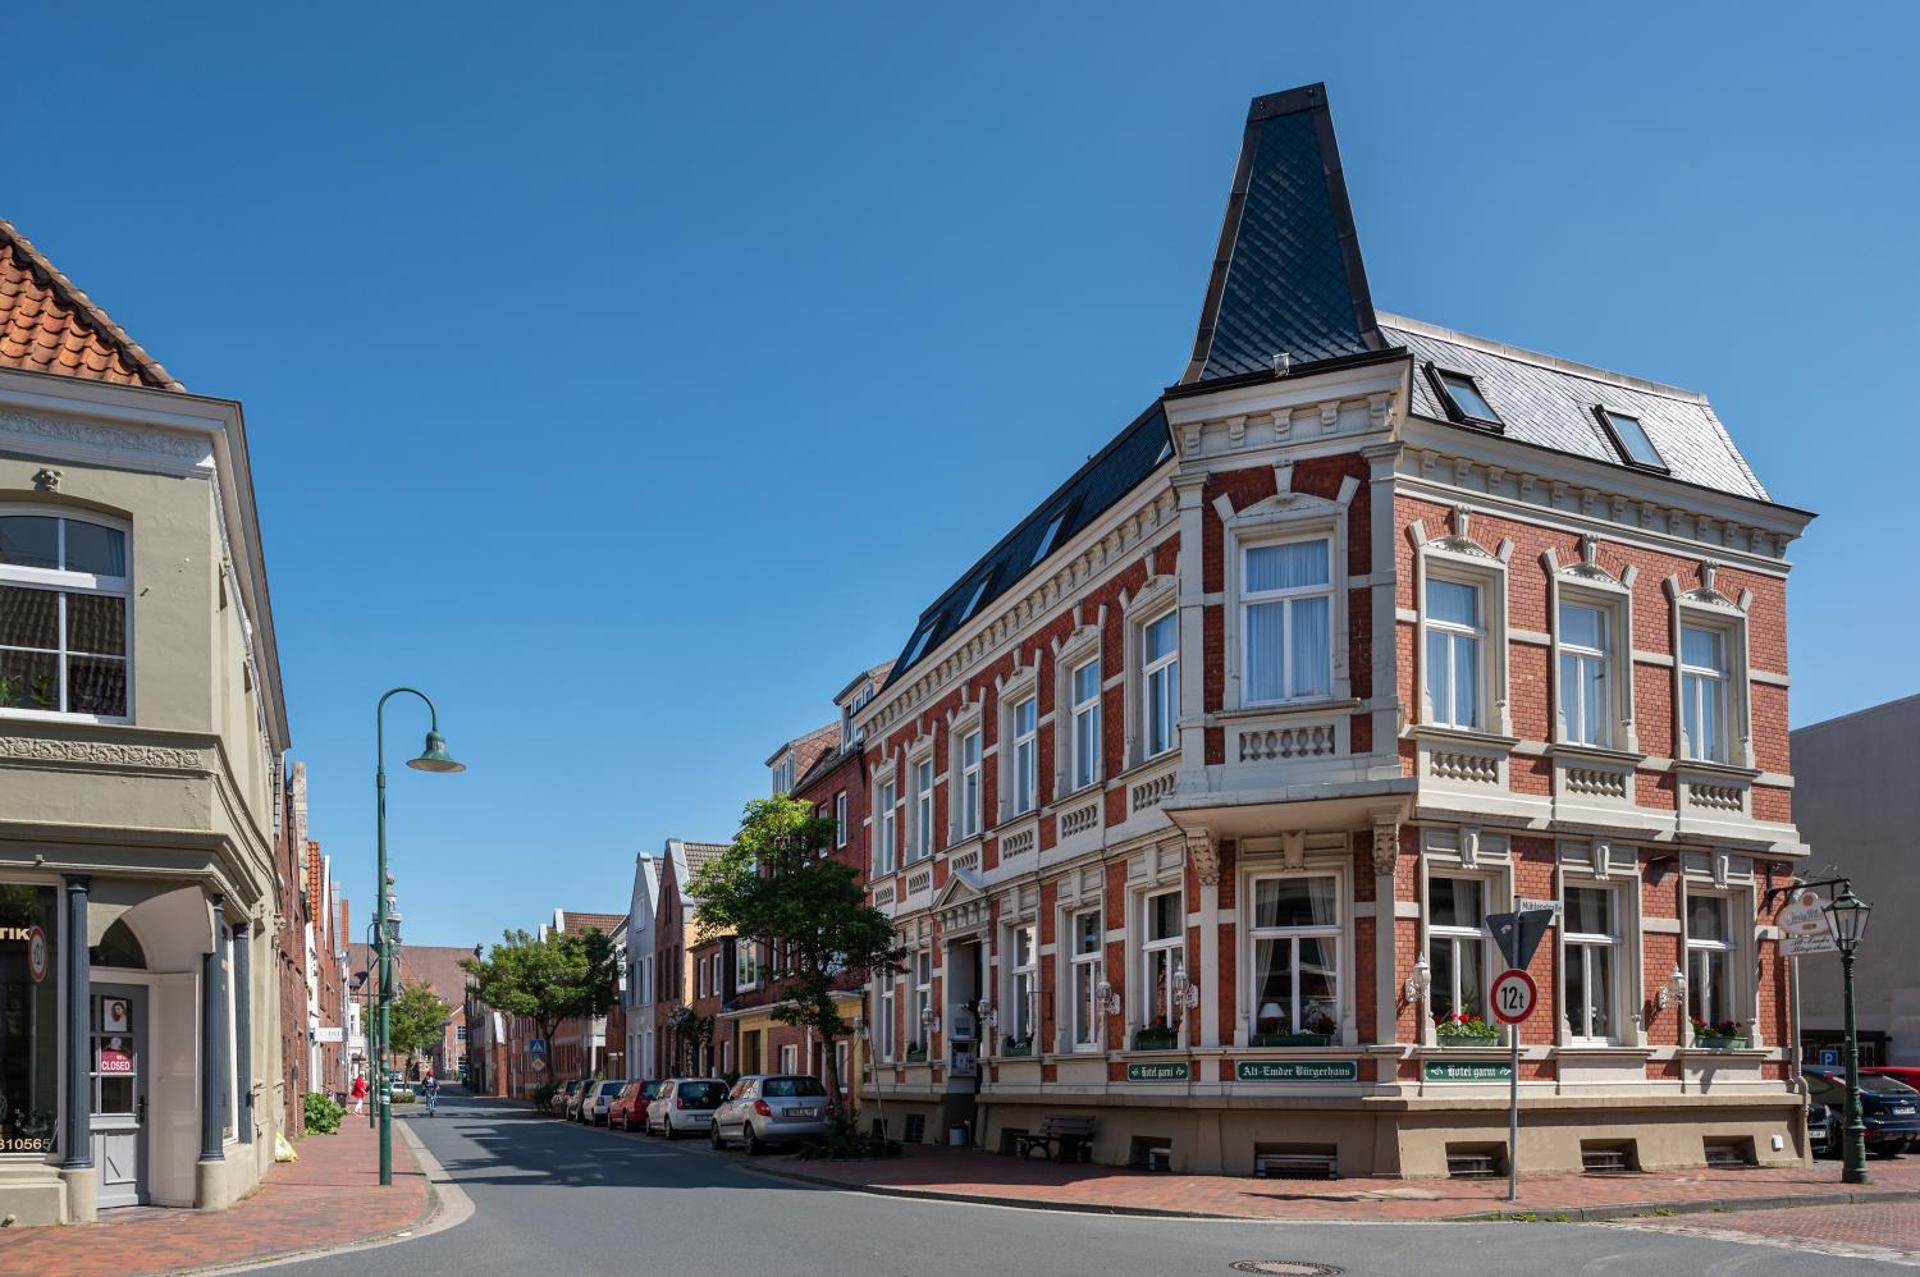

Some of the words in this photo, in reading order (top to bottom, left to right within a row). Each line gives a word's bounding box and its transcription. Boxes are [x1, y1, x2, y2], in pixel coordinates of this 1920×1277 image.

[102, 1061, 130, 1070] CLOSED
[1243, 1066, 1293, 1077] Alt-Emder
[1295, 1066, 1350, 1078] Bürgerhaus
